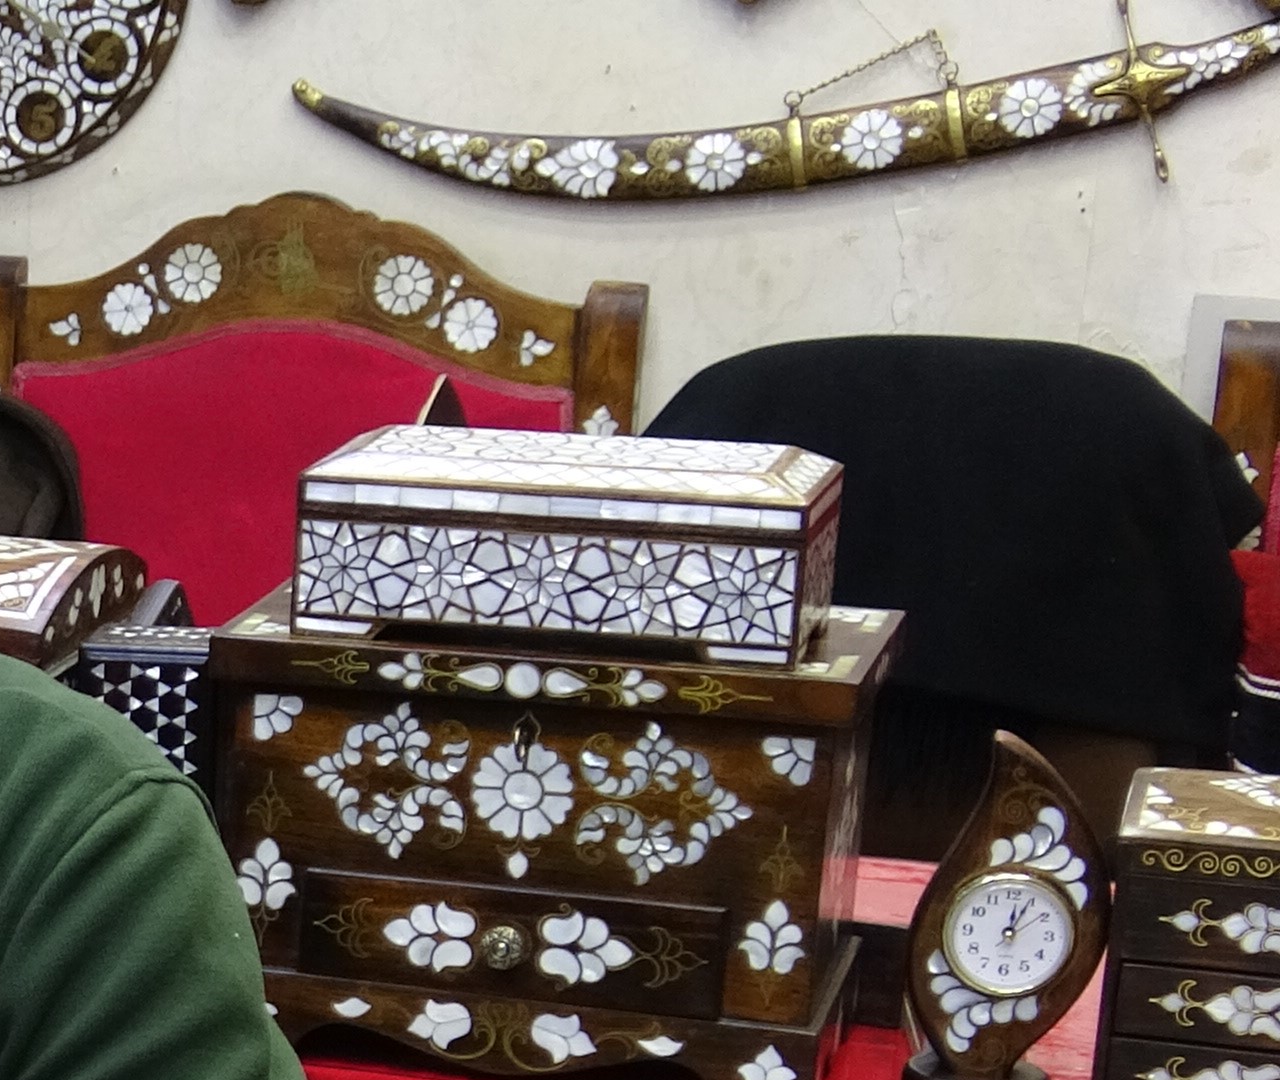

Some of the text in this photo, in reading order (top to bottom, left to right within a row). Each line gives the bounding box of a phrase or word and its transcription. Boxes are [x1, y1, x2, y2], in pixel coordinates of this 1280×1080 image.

[30, 101, 57, 139] 5
[986, 894, 999, 906] 11
[1006, 889, 1022, 901] 12
[971, 906, 986, 918] 10
[1040, 912, 1050, 923] 2
[962, 923, 974, 936] 9
[1043, 930, 1055, 942] 3
[967, 942, 979, 955] 8
[1034, 948, 1045, 960] 4
[980, 956, 990, 969] 7
[1019, 960, 1030, 972] 5
[998, 963, 1010, 977] 6
